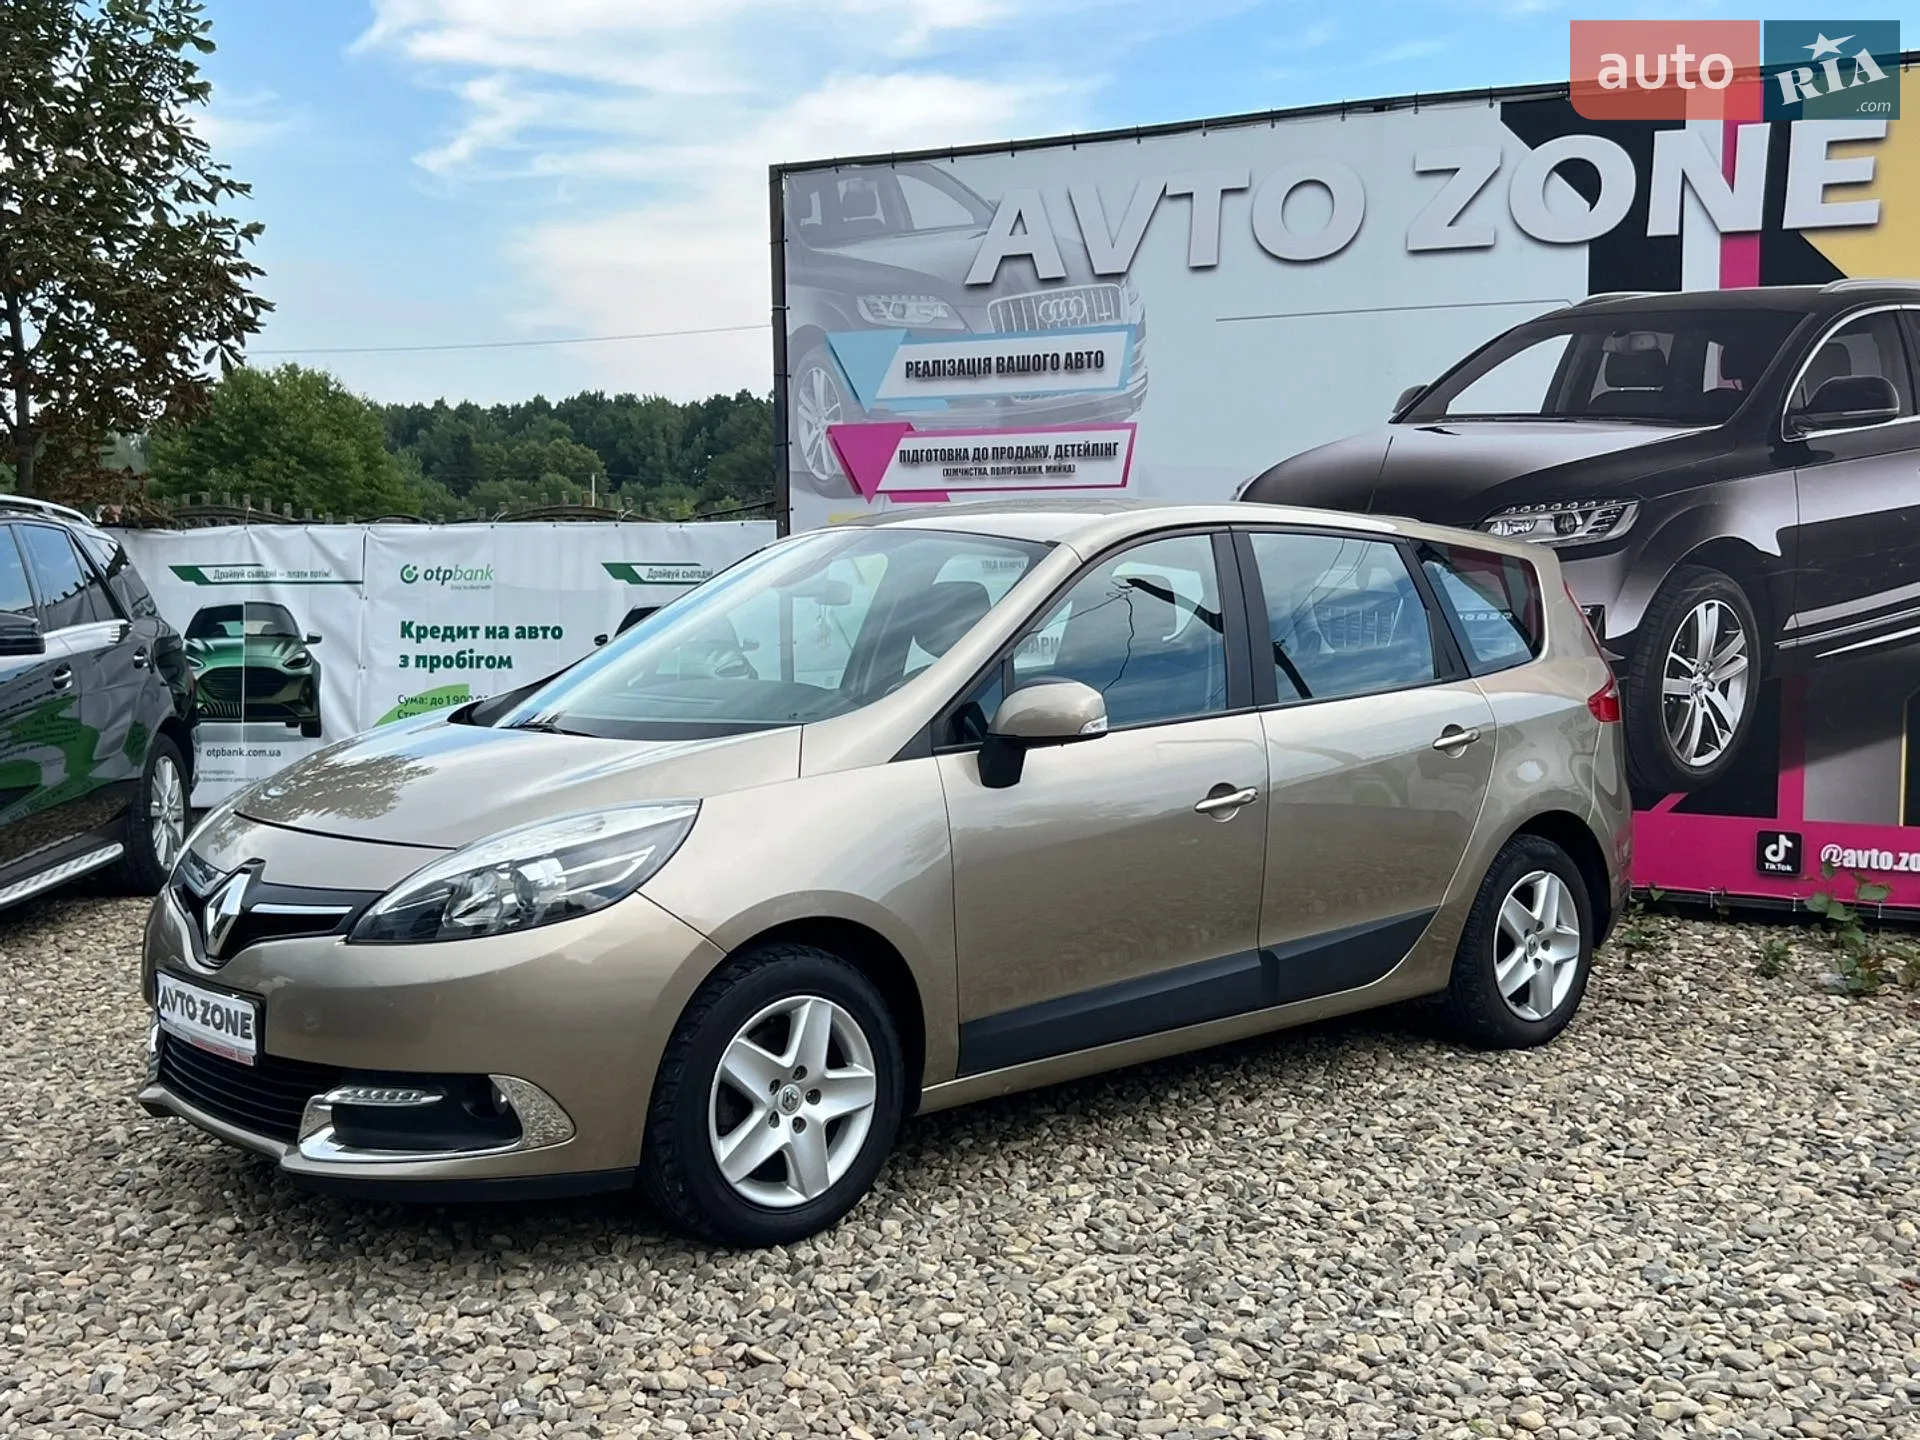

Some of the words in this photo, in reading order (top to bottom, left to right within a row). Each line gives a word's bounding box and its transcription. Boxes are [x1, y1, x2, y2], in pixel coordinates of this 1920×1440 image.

[964, 158, 1367, 285] AVTO
[1407, 119, 1888, 251] ZONE
[905, 357, 992, 378] РЕАЛІЗАЦІЯ
[996, 353, 1060, 374] ВАШОГО
[1063, 350, 1105, 370] АВТО
[899, 447, 969, 464] ПІДГОТОВКА
[972, 447, 989, 463] ДО
[1053, 440, 1119, 460] ДЕТЕЙЛІНГ
[423, 564, 493, 586] otpbank
[400, 620, 480, 644] Кредит
[484, 625, 509, 640] на
[514, 625, 564, 640] авто
[399, 654, 409, 668] з
[415, 649, 513, 673] пробігом
[397, 694, 428, 707] Сума:
[430, 696, 444, 707] до
[206, 747, 281, 759] otpbank.com.ua
[1764, 862, 1793, 872] TikTok
[160, 985, 197, 1021] AVTO
[200, 999, 253, 1040] ZONE
